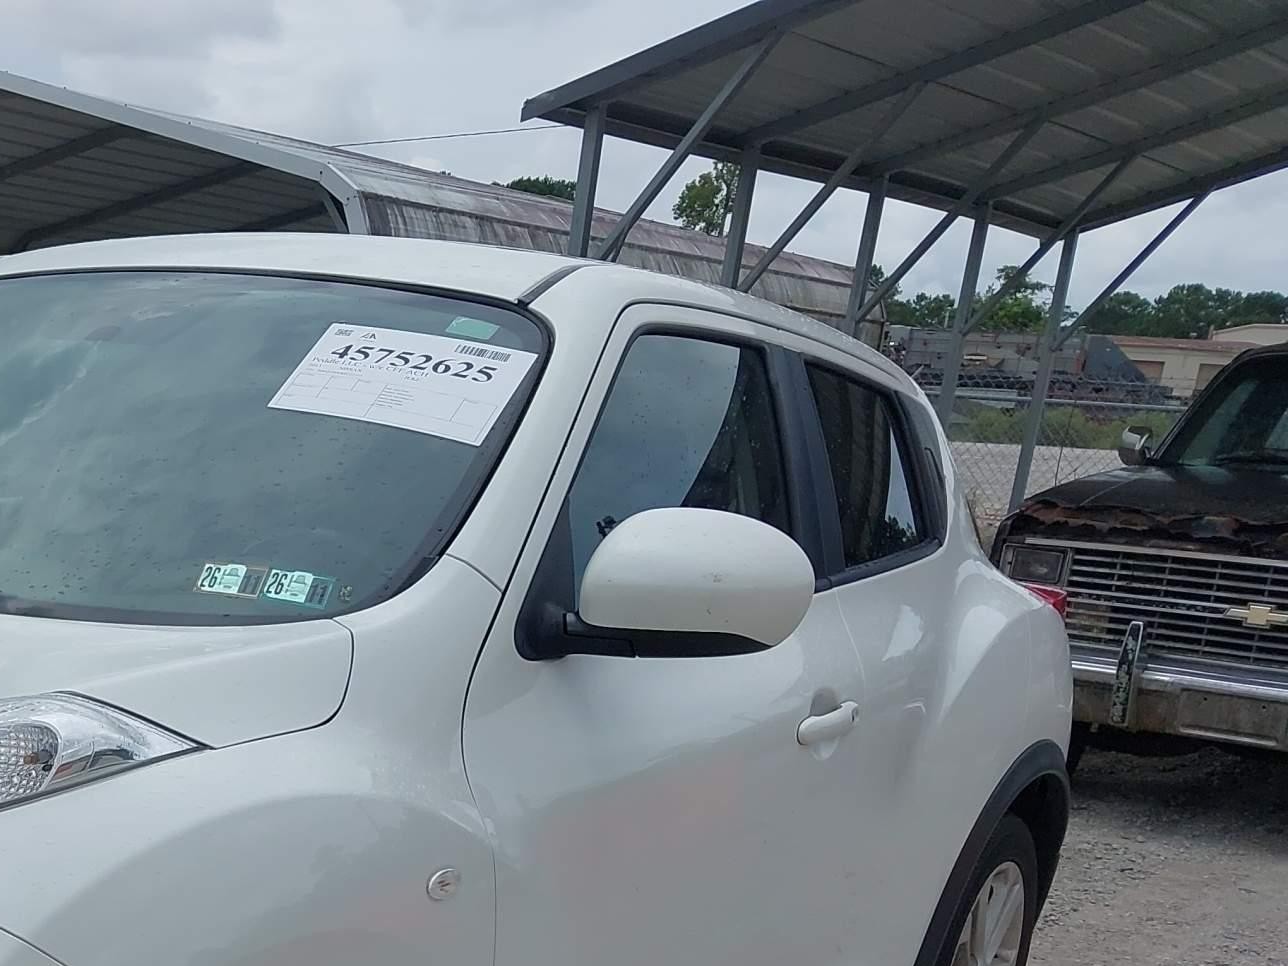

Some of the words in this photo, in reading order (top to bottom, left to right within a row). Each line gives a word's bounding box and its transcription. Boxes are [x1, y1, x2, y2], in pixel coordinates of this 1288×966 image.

[330, 344, 497, 382] 45752625
[200, 566, 221, 588] 26
[265, 572, 288, 595] 26
